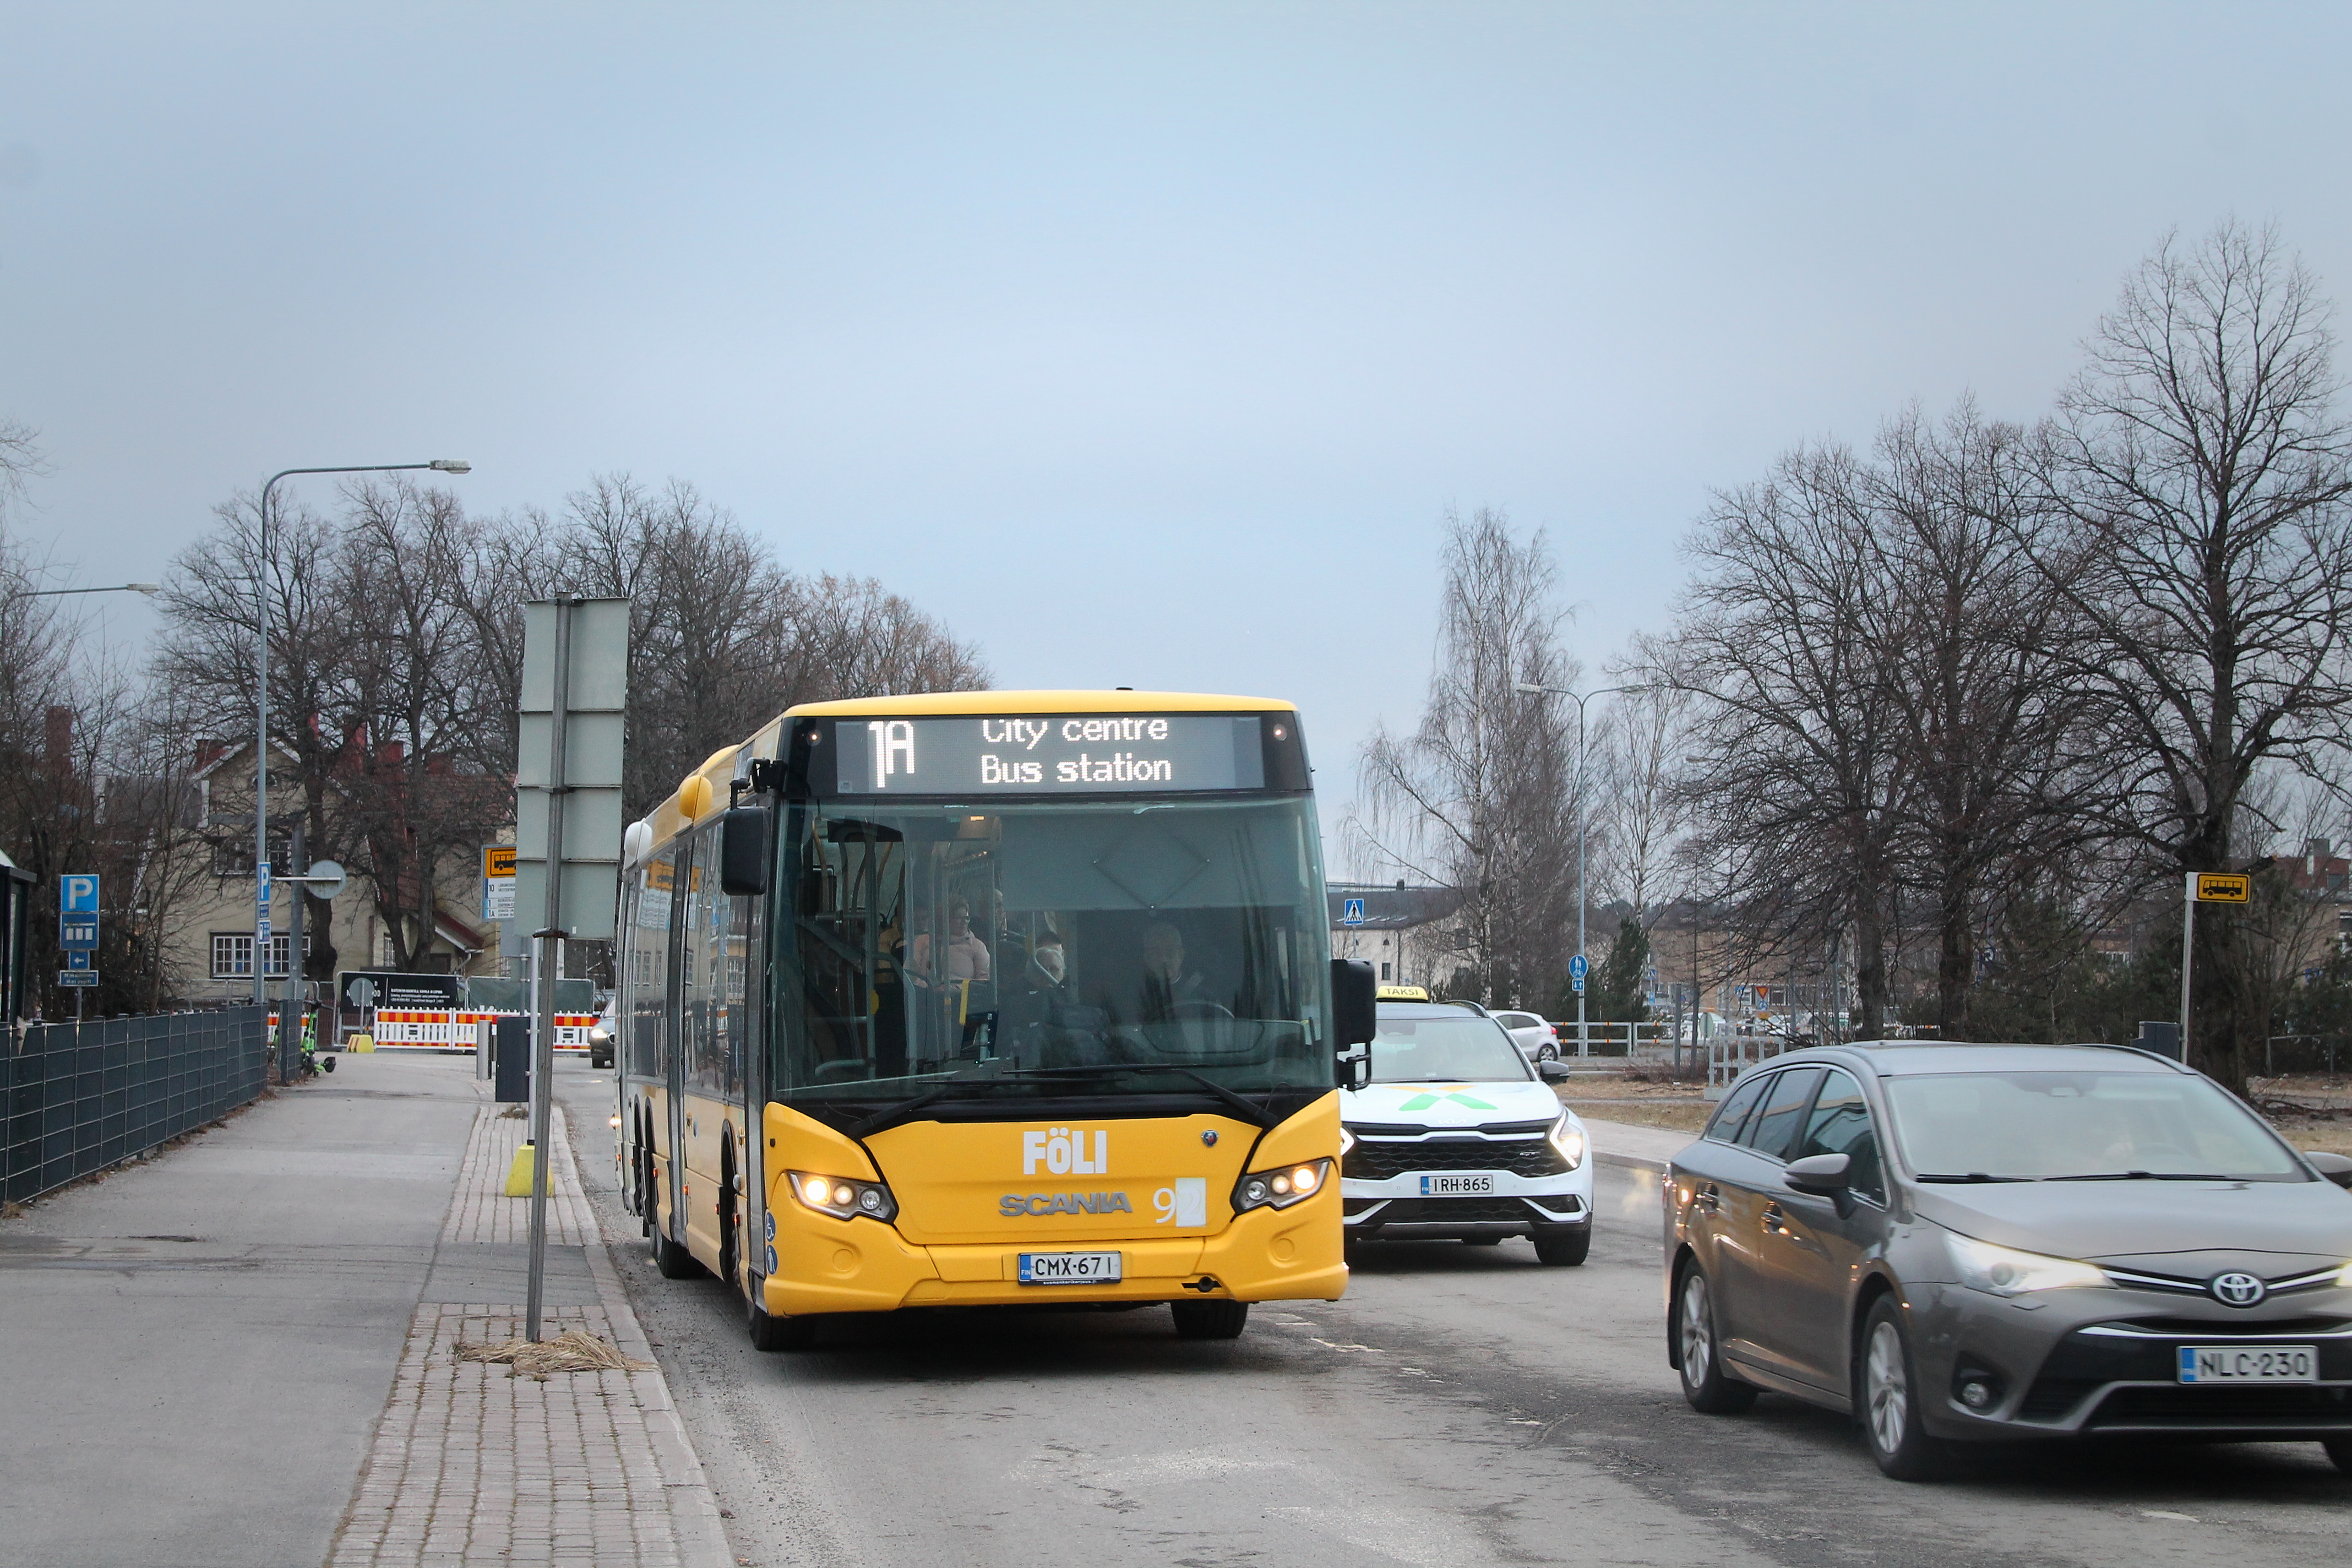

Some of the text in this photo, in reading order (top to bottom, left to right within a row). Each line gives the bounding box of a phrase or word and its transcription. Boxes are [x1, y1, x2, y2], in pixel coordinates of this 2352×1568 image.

[982, 717, 1169, 750] City centre
[868, 720, 915, 788] 1A
[981, 752, 1172, 784] Bus station
[69, 878, 94, 909] P
[1434, 1178, 1490, 1192] IRH-865
[999, 1191, 1133, 1217] SCANIA
[1035, 1257, 1111, 1276] CMX-671
[2201, 1353, 2309, 1376] NLC-230
